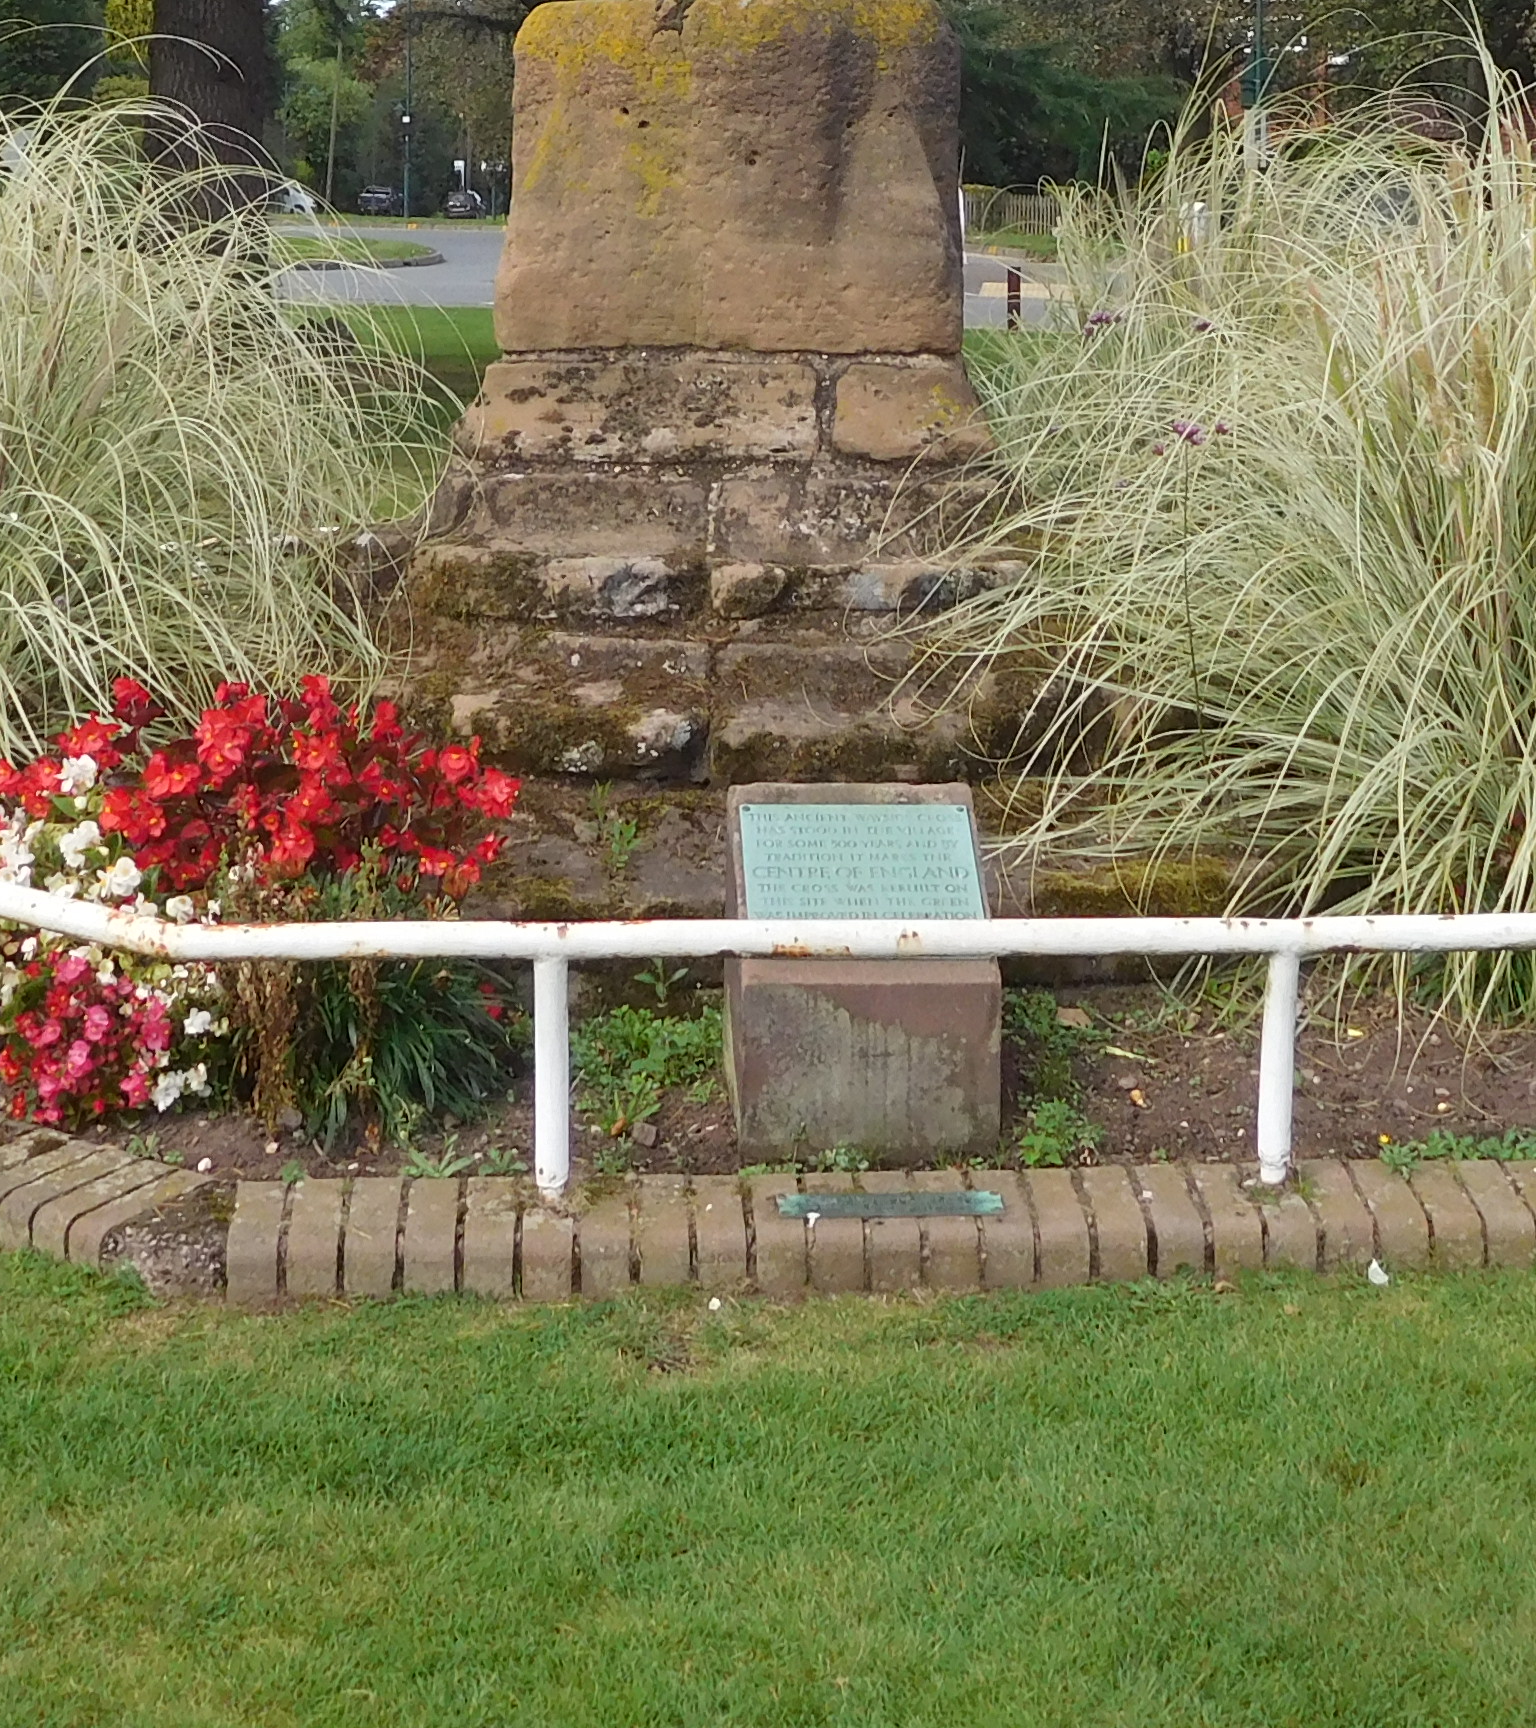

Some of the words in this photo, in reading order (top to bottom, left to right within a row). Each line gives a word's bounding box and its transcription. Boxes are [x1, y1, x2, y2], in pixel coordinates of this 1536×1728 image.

[785, 813, 846, 822] ANCIENT
[896, 826, 955, 834] VILLAGE
[756, 839, 783, 848] FOR
[787, 839, 825, 848] SOME
[906, 839, 937, 848] AND
[765, 853, 843, 862] TRADITION
[850, 853, 863, 862] IT
[923, 853, 951, 862] THE
[752, 866, 829, 879] CENTRE
[835, 866, 863, 879] OF
[869, 866, 969, 879] ENGLAND
[757, 883, 783, 892] THE
[791, 883, 839, 892] CROSS
[846, 883, 873, 892] WAS
[945, 883, 968, 892] ON
[922, 897, 970, 906] GREEN
